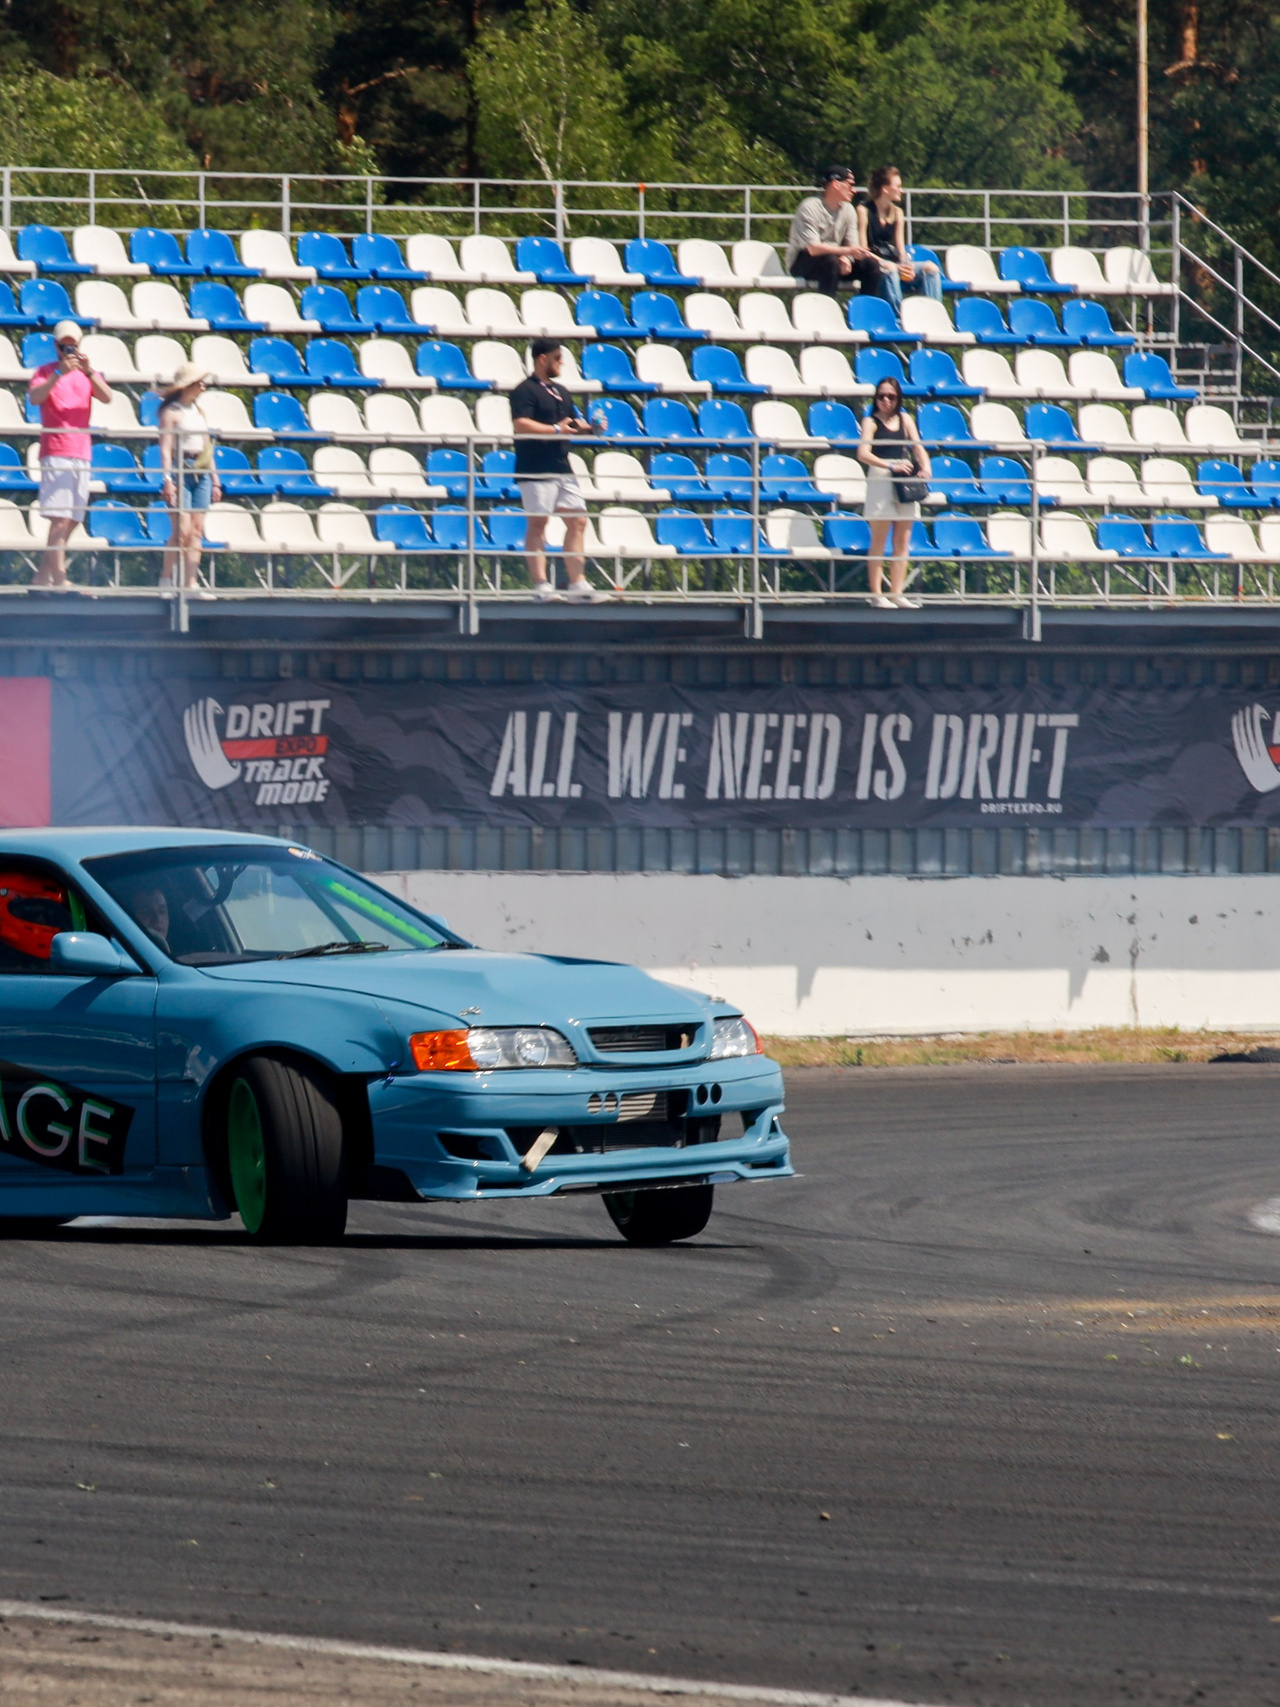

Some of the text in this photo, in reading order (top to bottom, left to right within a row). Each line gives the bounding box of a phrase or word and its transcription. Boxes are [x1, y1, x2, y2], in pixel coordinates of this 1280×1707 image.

[226, 700, 331, 738] DRIFT
[490, 711, 1080, 800] ALL WE NEED IS DRIFT
[244, 757, 325, 783] TRACK
[256, 780, 330, 806] MODE
[981, 803, 1063, 814] DRIFTEXPO.RU
